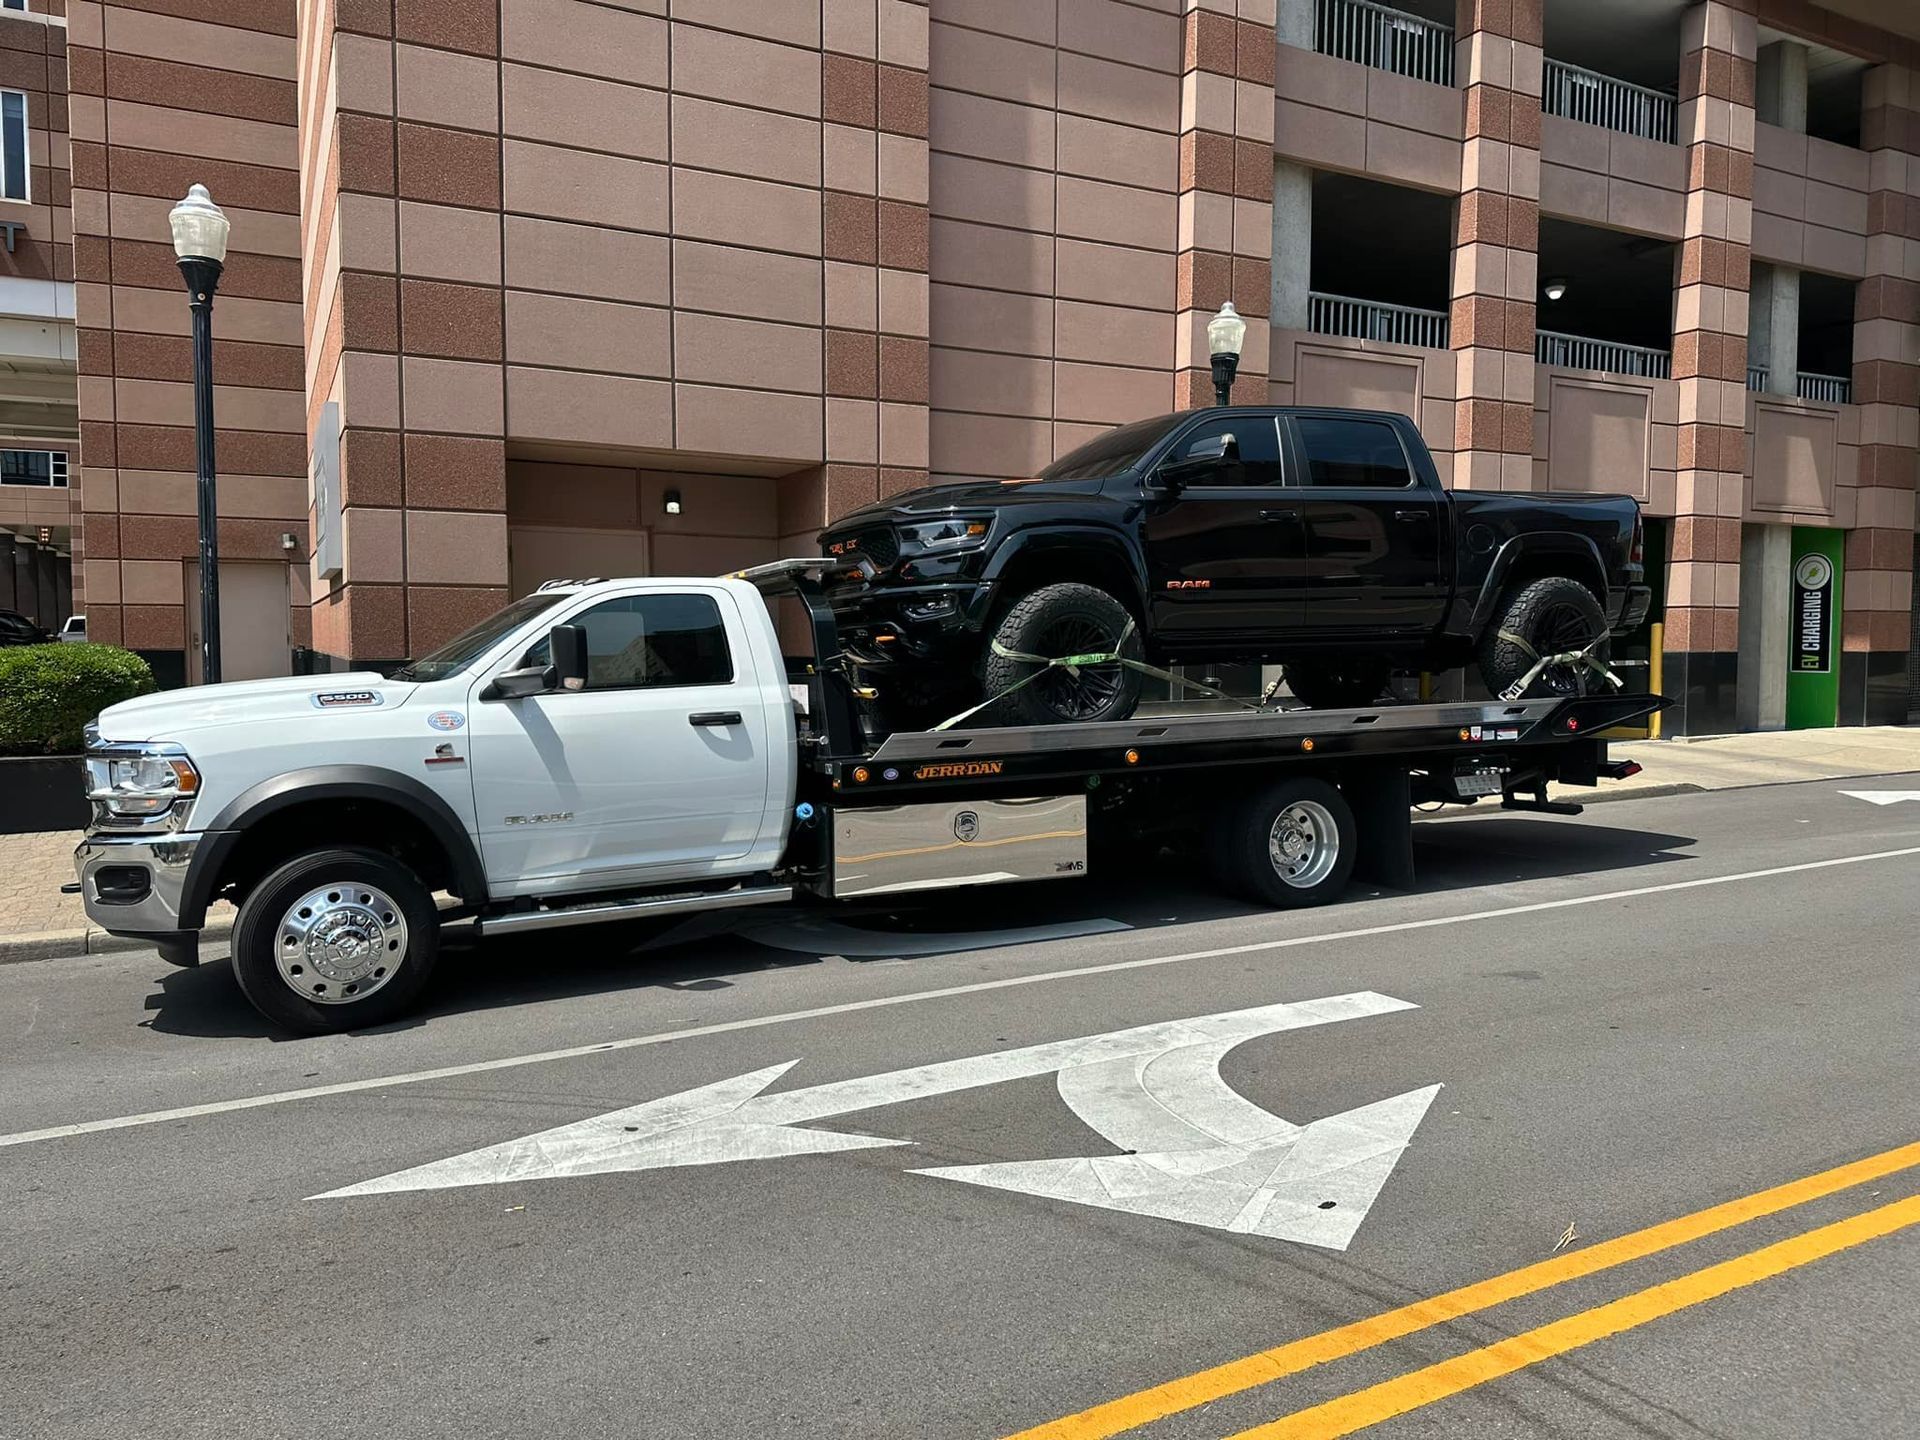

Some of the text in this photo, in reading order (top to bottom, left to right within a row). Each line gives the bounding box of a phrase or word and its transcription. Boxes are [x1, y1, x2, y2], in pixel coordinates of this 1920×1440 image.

[1166, 580, 1211, 589] RAM
[1801, 591, 1821, 668] EV CHARGING
[319, 693, 369, 702] 5500
